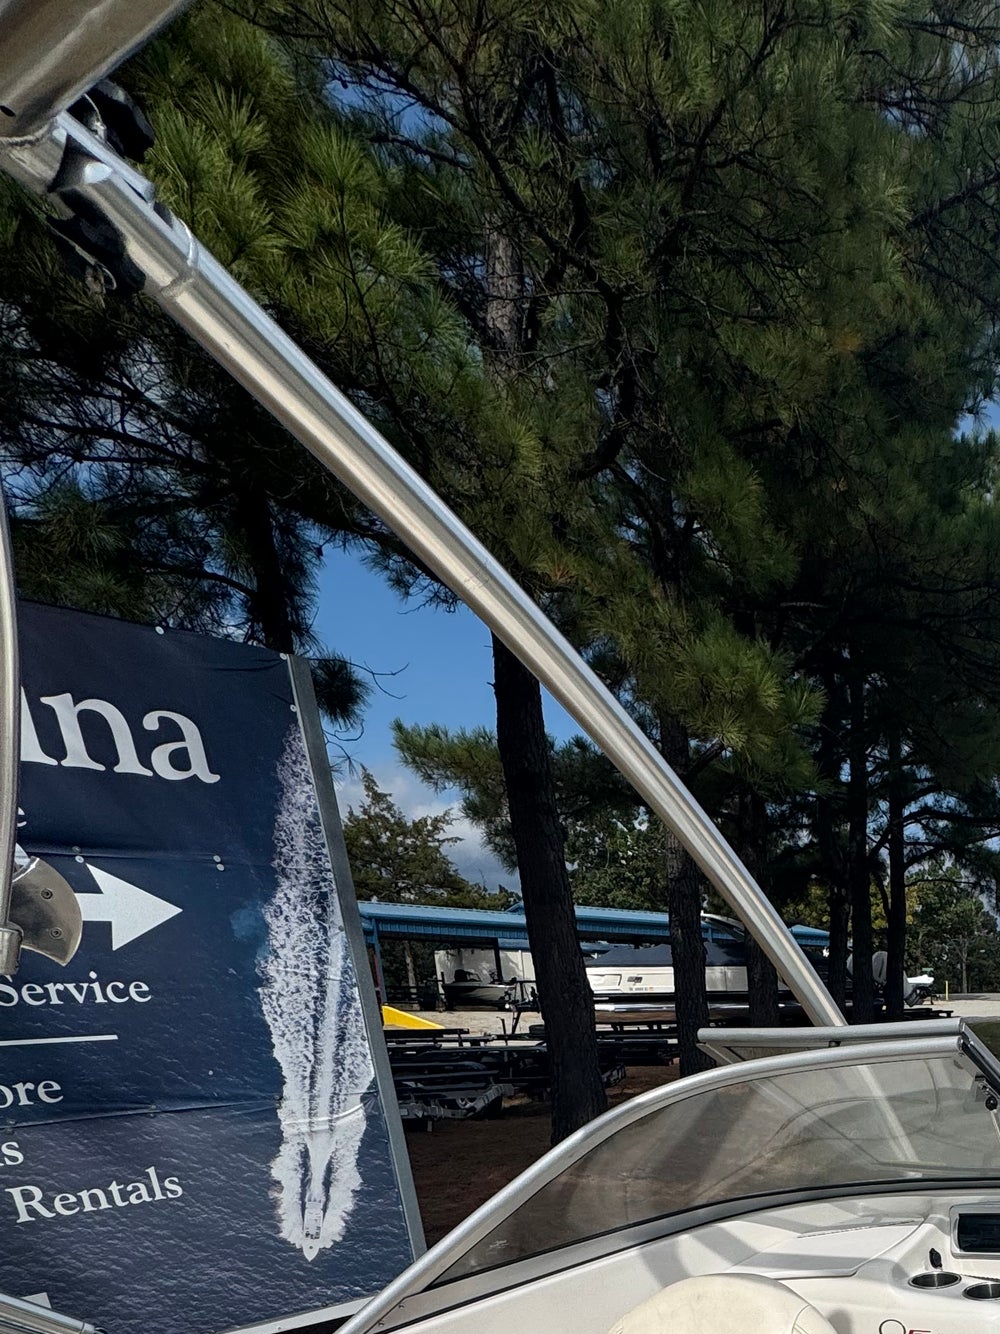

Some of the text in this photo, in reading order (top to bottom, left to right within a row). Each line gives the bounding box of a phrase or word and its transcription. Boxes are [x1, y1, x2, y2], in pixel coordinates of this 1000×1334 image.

[0, 970, 152, 1008] Service
[0, 1140, 25, 1167] s
[4, 1165, 184, 1225] Rentals
